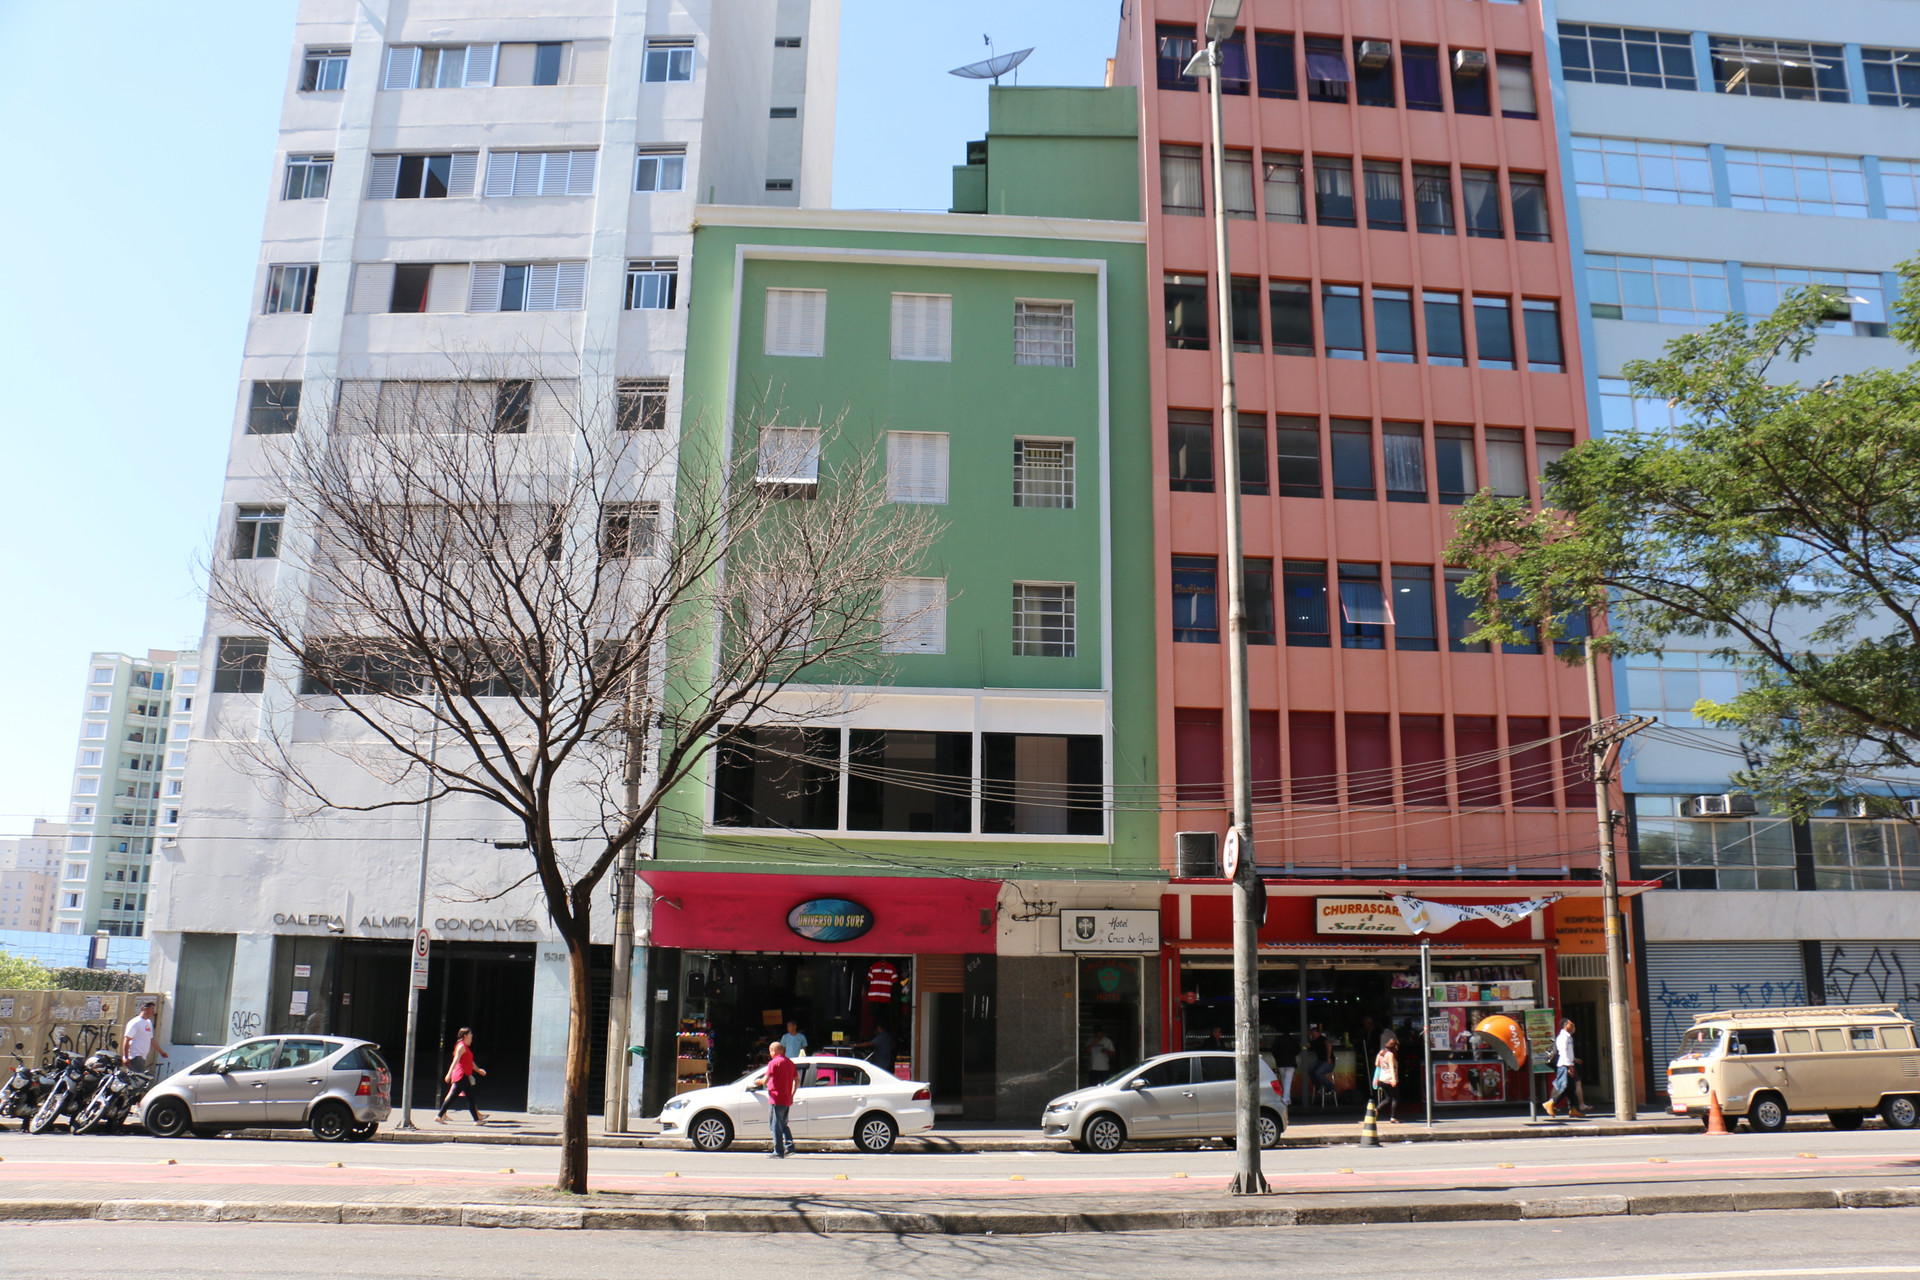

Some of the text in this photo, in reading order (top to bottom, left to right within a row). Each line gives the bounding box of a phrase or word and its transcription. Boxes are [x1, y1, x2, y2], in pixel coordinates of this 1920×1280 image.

[1175, 584, 1214, 595] Sindicato
[1323, 904, 1401, 916] CHURRASCAR
[273, 913, 344, 927] GALERIA
[435, 918, 537, 932] GONÇALVES
[798, 915, 864, 928] UNIVERSO DO SURF
[1109, 917, 1128, 930] Hotel
[1328, 922, 1396, 931] Saloia
[420, 935, 425, 951] E
[1108, 933, 1124, 943] Cruz
[1128, 934, 1136, 943] de
[544, 953, 565, 962] 538
[1509, 1025, 1521, 1048] vivo
